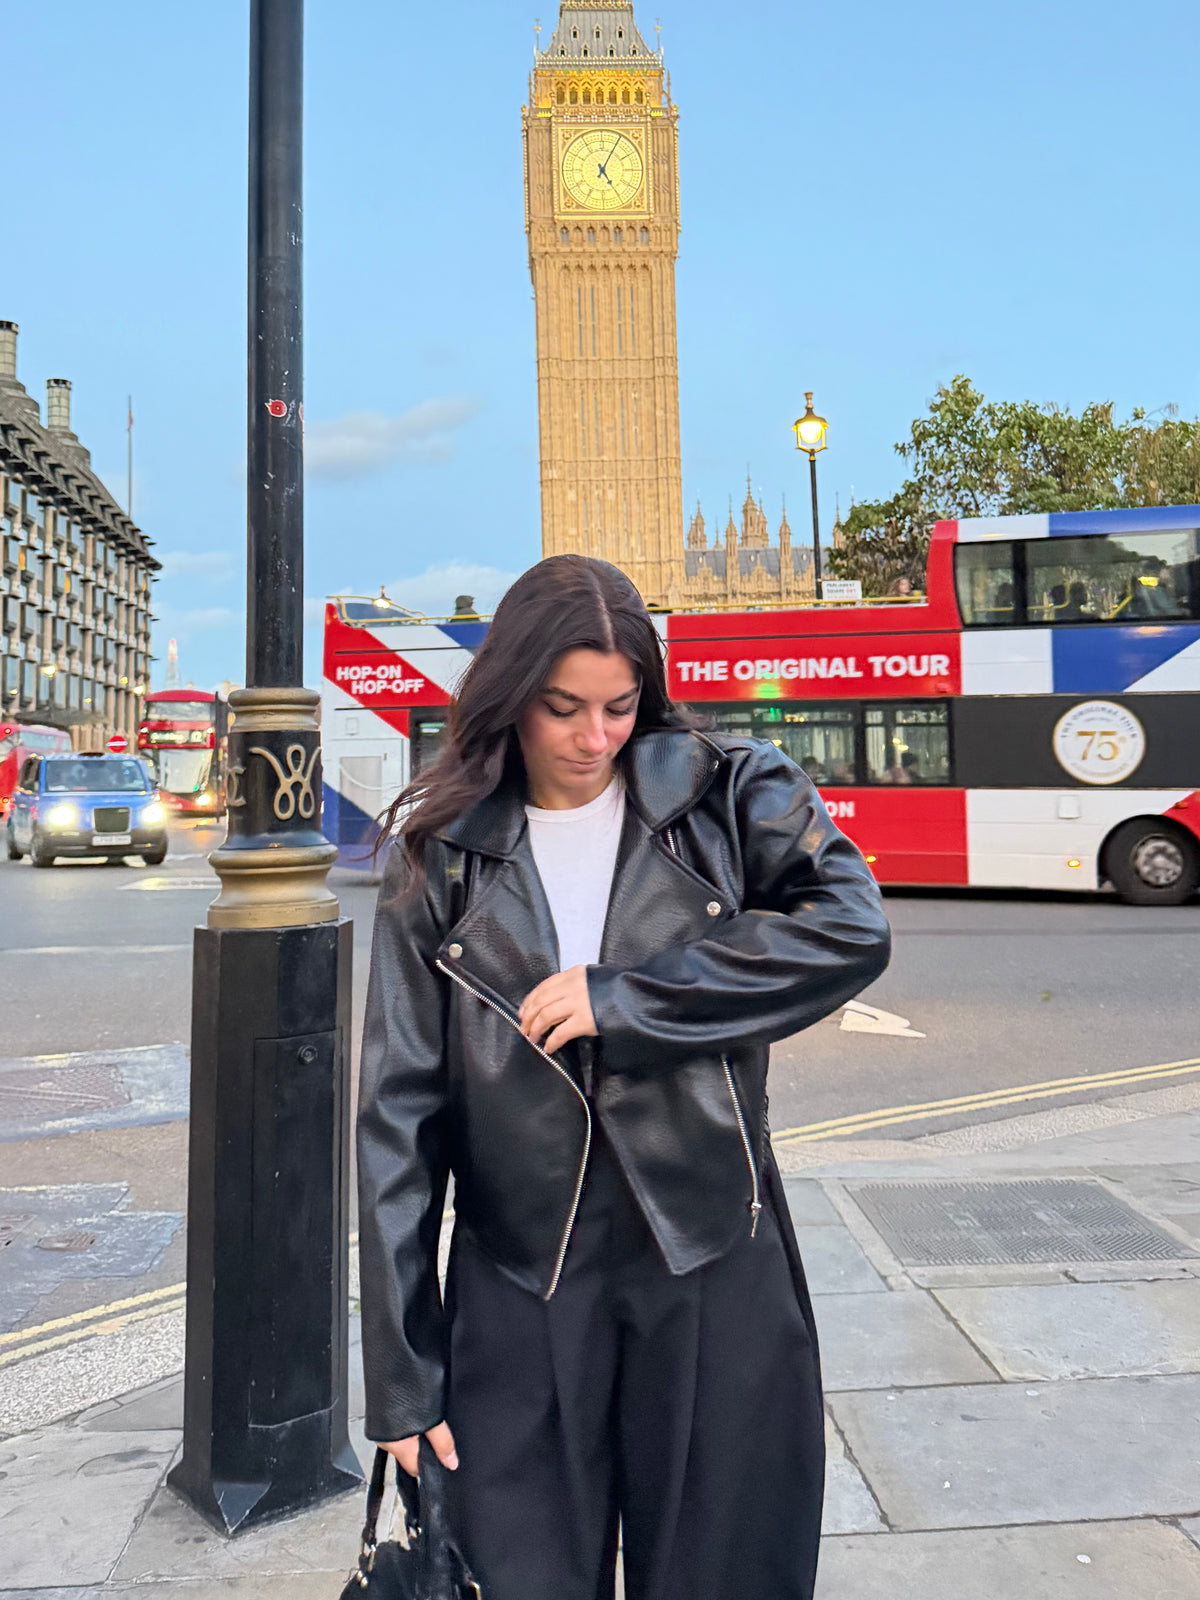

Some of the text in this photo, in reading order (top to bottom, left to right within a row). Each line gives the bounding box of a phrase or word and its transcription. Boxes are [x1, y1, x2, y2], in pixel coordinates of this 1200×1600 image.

[336, 664, 402, 681] HOP-ON
[676, 654, 951, 682] THE ORIGINAL TOUR
[351, 678, 425, 695] HOP-OFF
[1076, 730, 1120, 762] 75
